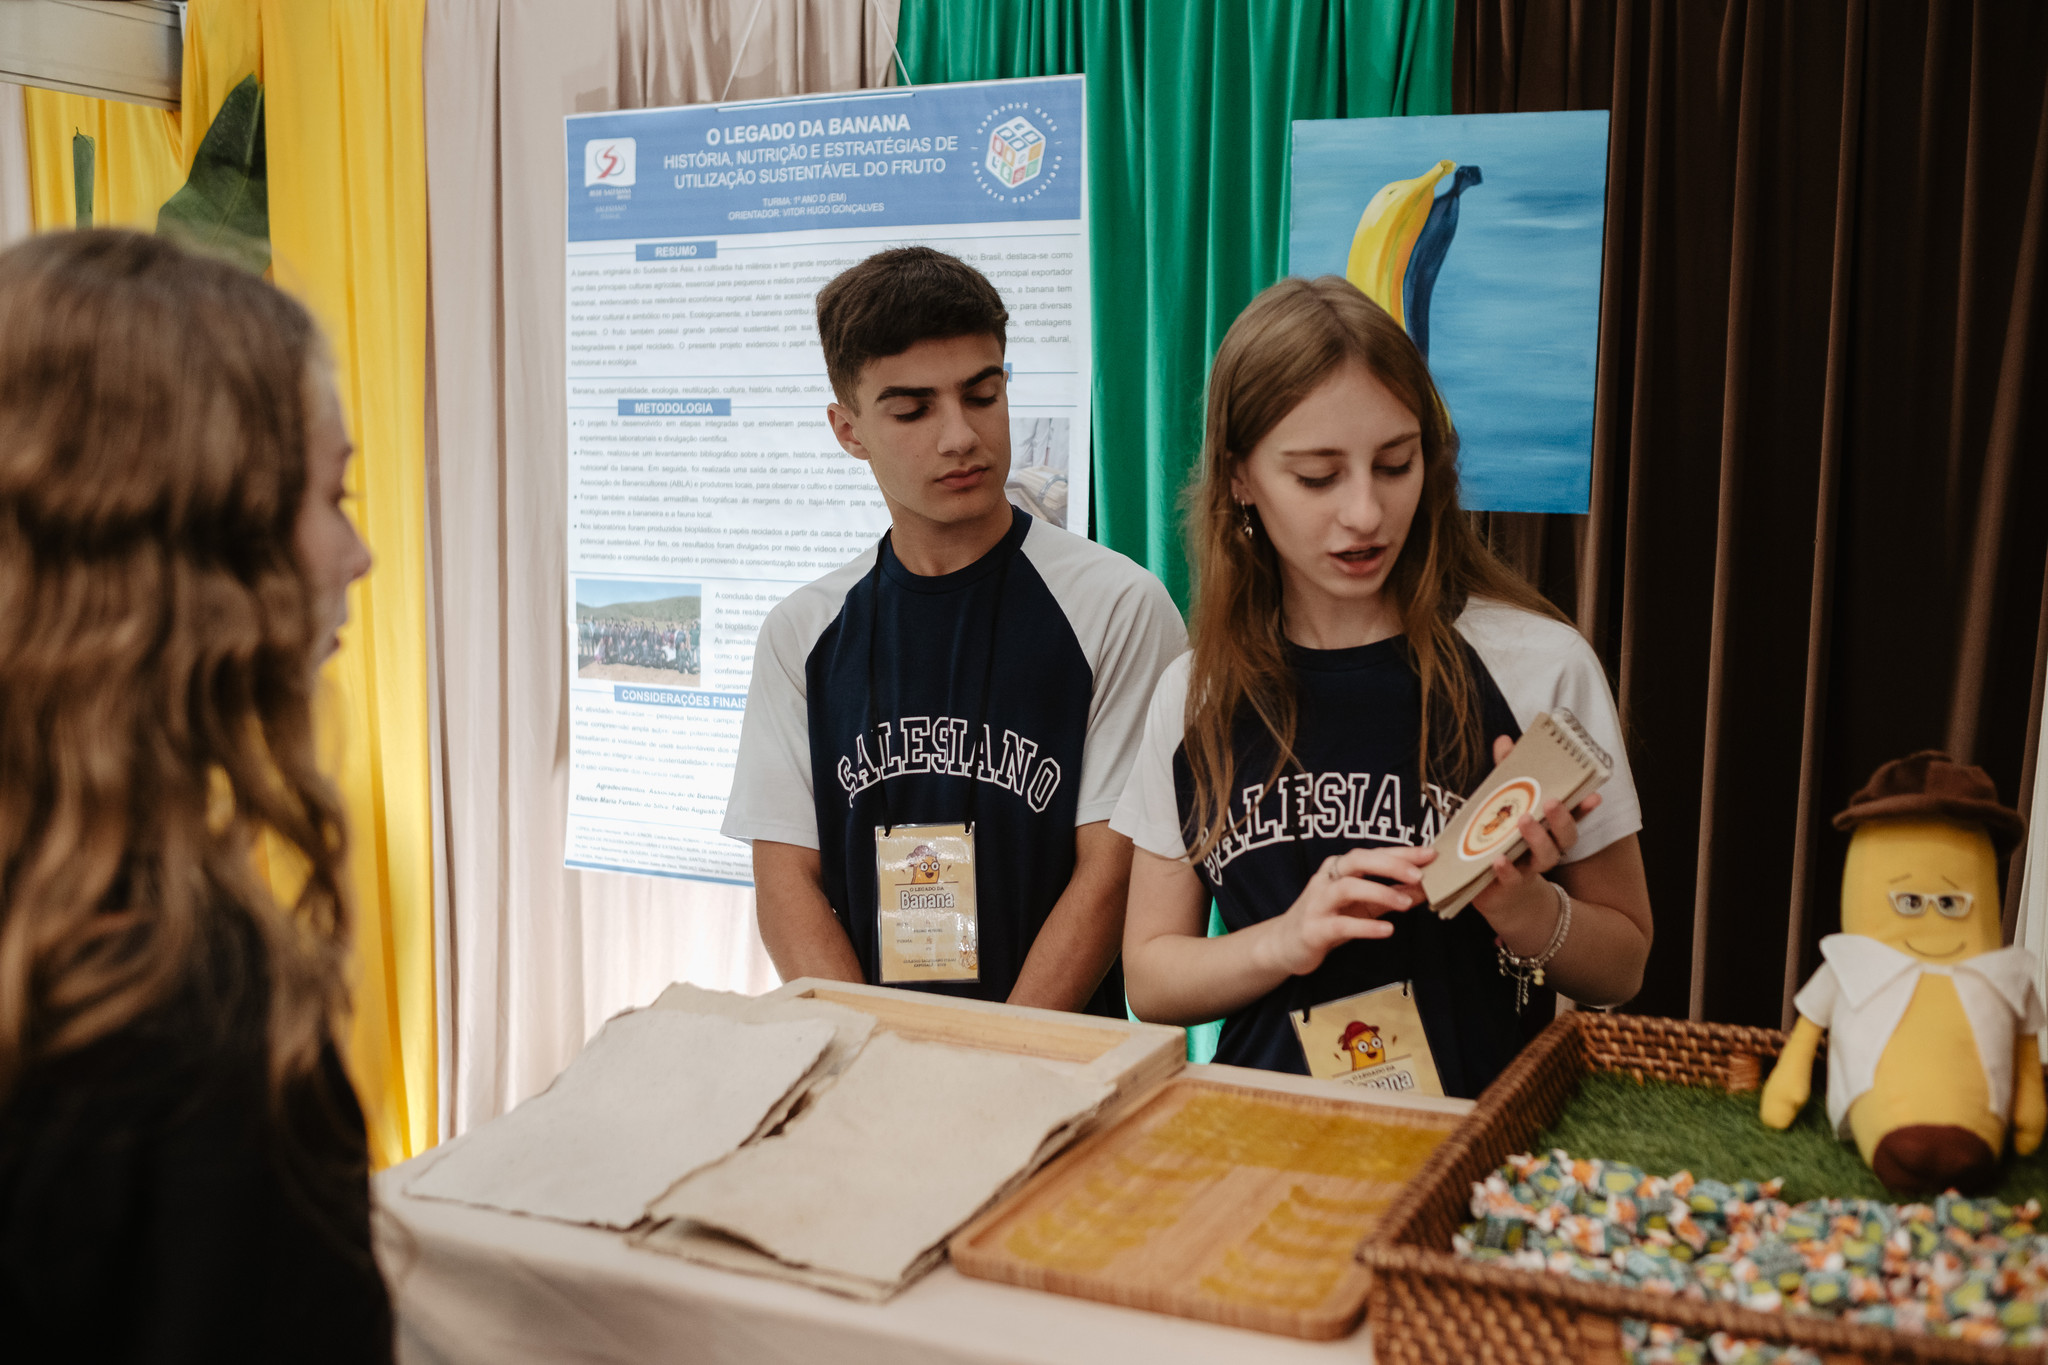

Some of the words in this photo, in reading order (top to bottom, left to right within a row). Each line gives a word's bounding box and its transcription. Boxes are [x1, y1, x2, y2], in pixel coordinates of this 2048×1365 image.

[706, 128, 719, 145] O
[724, 122, 794, 144] LEGADO
[799, 119, 824, 137] DA
[828, 113, 910, 135] BANANA
[664, 151, 733, 169] HISTÓRIA,
[736, 145, 806, 164] NUTRIÇÃO
[810, 144, 819, 158] E
[824, 136, 930, 157] ESTRATÉGIAS
[935, 136, 958, 151] DE
[674, 170, 755, 188] UTILIZAÇÃO
[759, 162, 860, 183] SUSTENTÁVEL
[863, 161, 887, 176] DO
[891, 158, 945, 174] FRUTO
[801, 194, 817, 203] ANO
[819, 194, 825, 202] D
[827, 193, 846, 202] (EM)
[782, 207, 804, 216] VITOR
[806, 205, 829, 214] HUGO
[831, 202, 884, 213] GONÇALVES
[655, 246, 696, 256] RESUMO
[1005, 252, 1048, 260] destaca-se
[996, 269, 1029, 278] principal
[1030, 268, 1072, 277] exportador
[1024, 319, 1071, 328] embalagens
[635, 403, 713, 413] METODOLOGIA
[622, 690, 709, 706] CONSIDERAÇÕES
[713, 696, 746, 708] FINAIS
[838, 716, 1061, 813] SALESIANO
[900, 890, 954, 910] Banana
